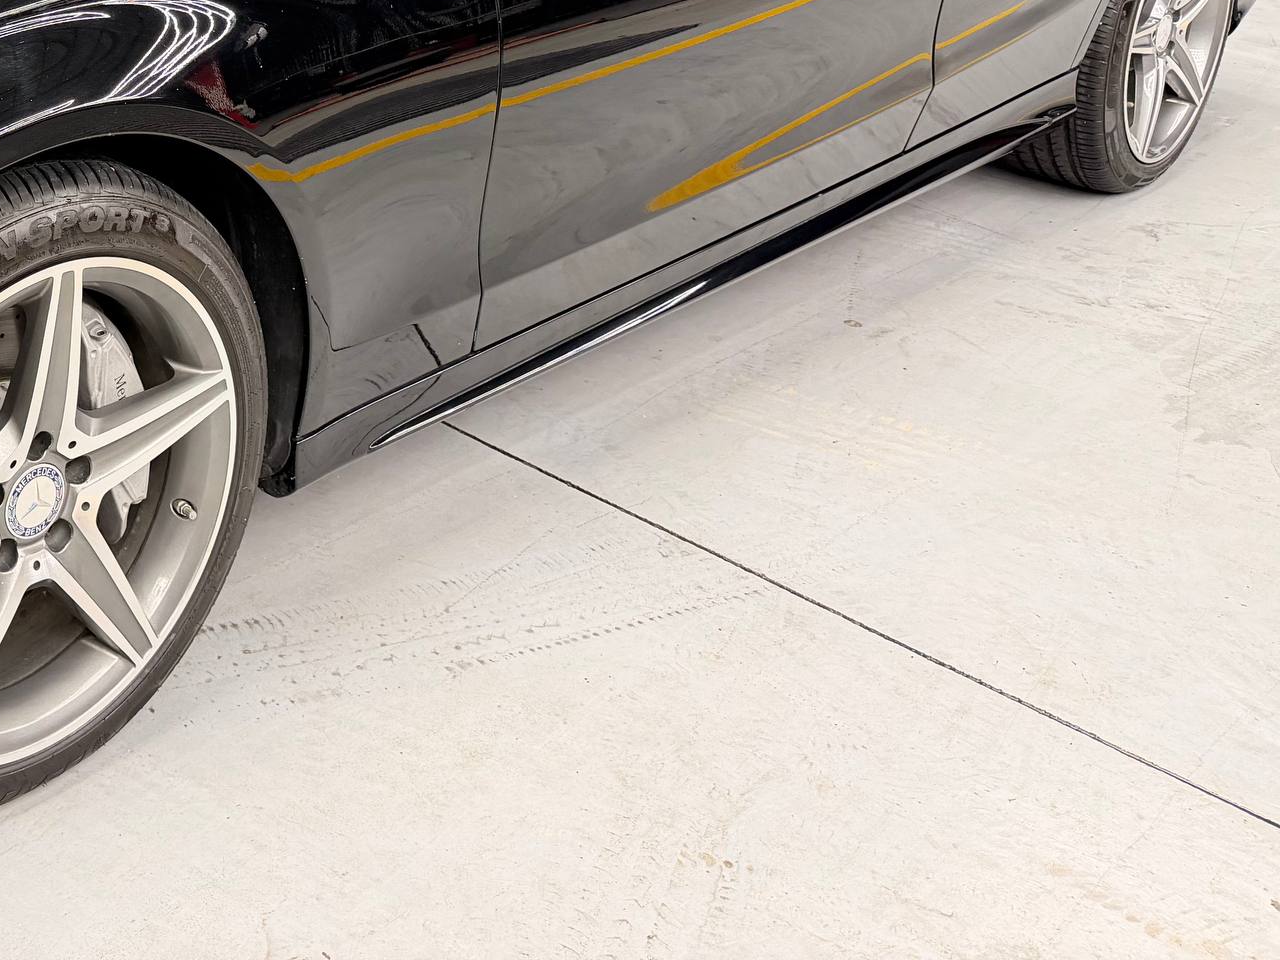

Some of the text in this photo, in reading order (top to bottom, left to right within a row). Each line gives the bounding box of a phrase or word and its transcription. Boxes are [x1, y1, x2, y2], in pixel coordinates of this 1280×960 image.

[28, 204, 151, 249] SPORT
[15, 466, 57, 494] MERCEDES
[24, 522, 49, 537] BENZ
